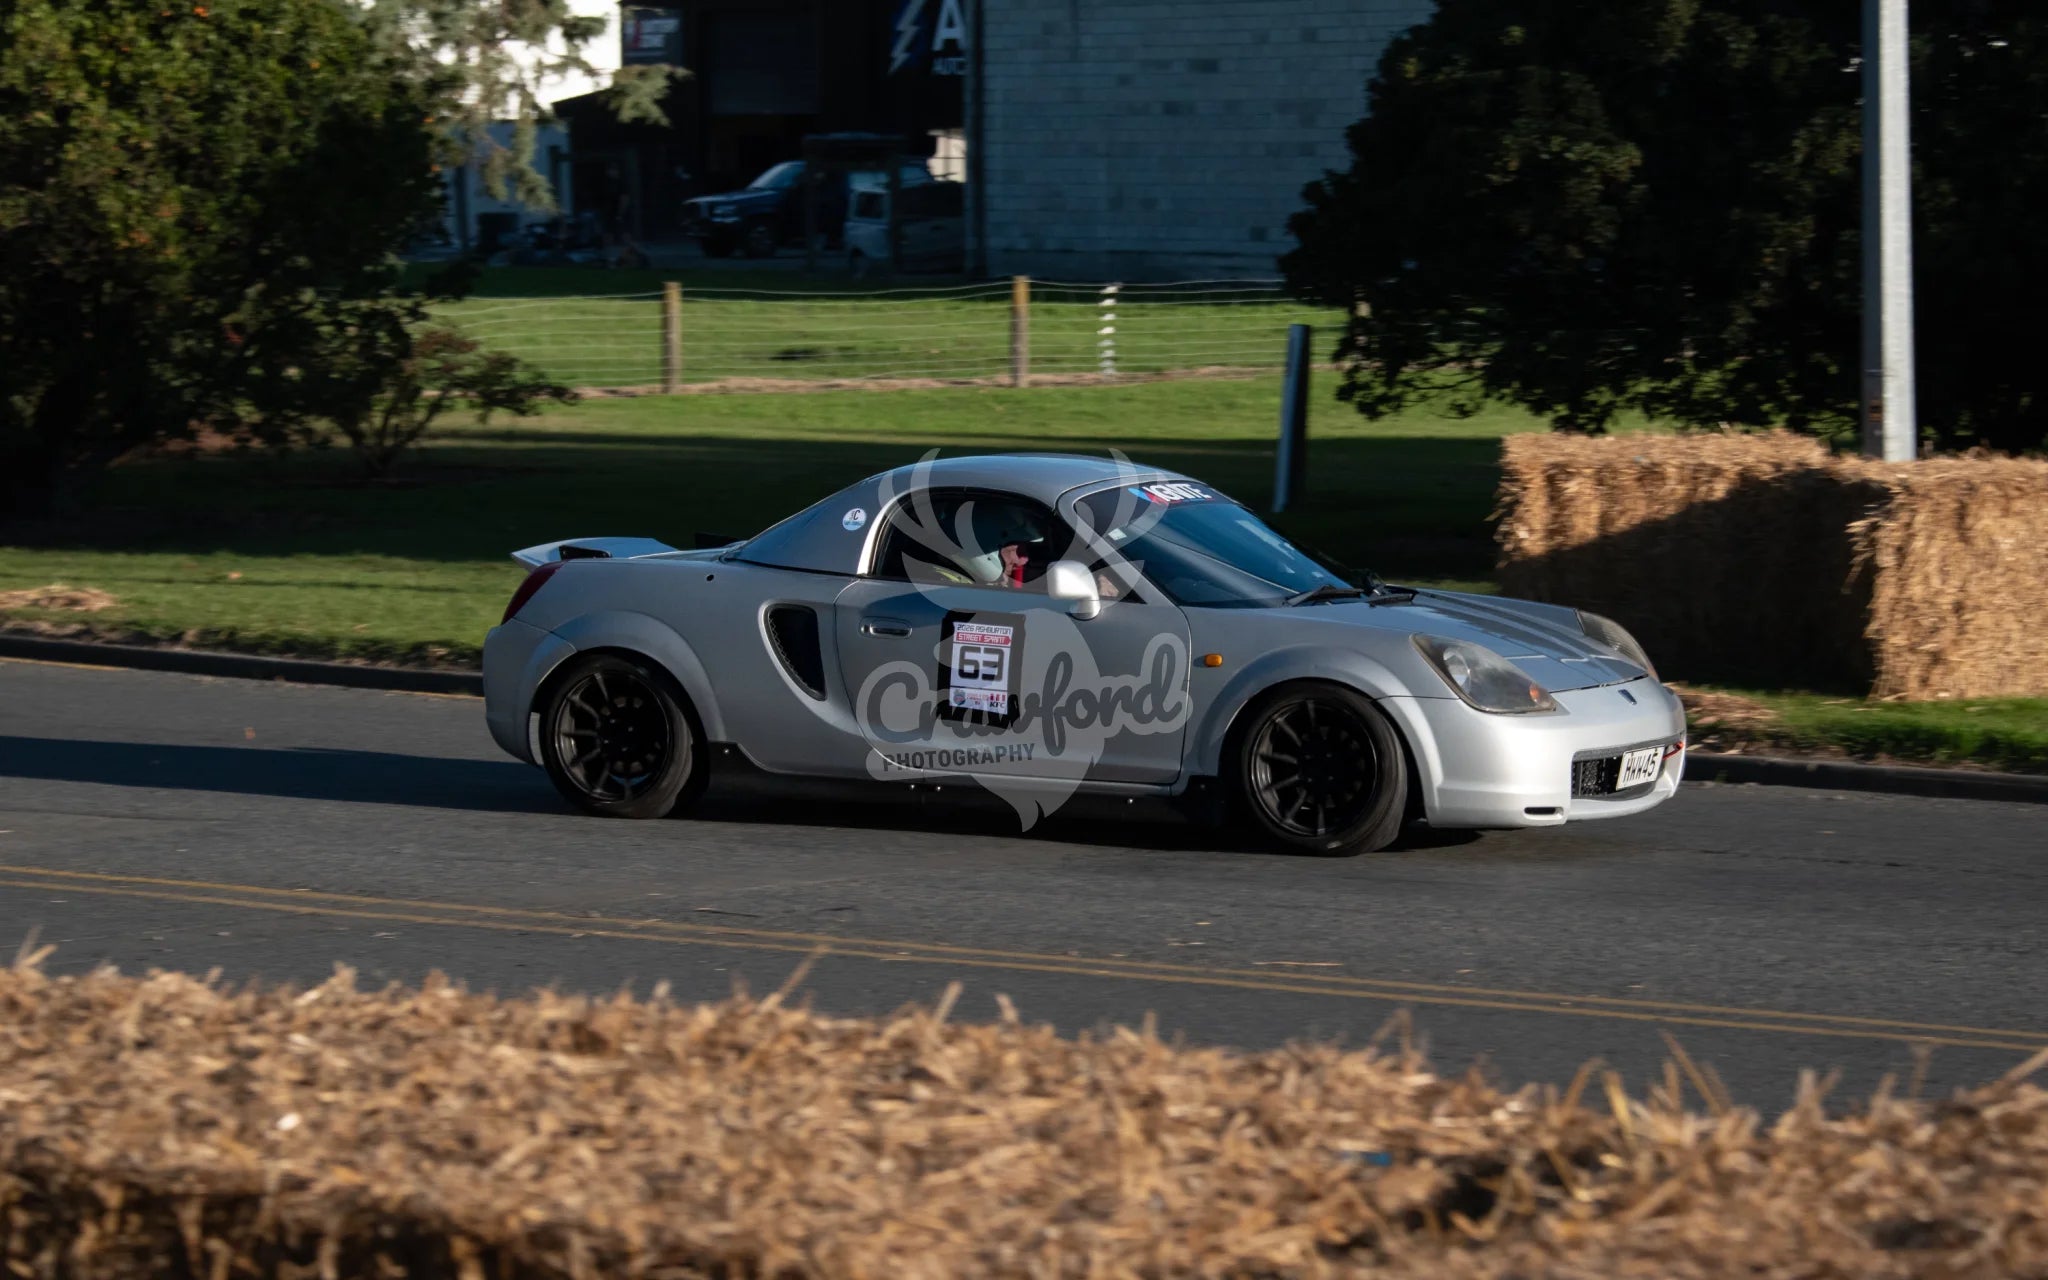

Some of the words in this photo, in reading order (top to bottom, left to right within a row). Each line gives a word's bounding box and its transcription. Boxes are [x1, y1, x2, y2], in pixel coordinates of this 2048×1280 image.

[957, 624, 975, 632] 2026
[975, 626, 1012, 635] ASHBURTON
[958, 633, 982, 642] STREET
[983, 635, 1006, 644] SPRINT
[958, 645, 1004, 682] 63
